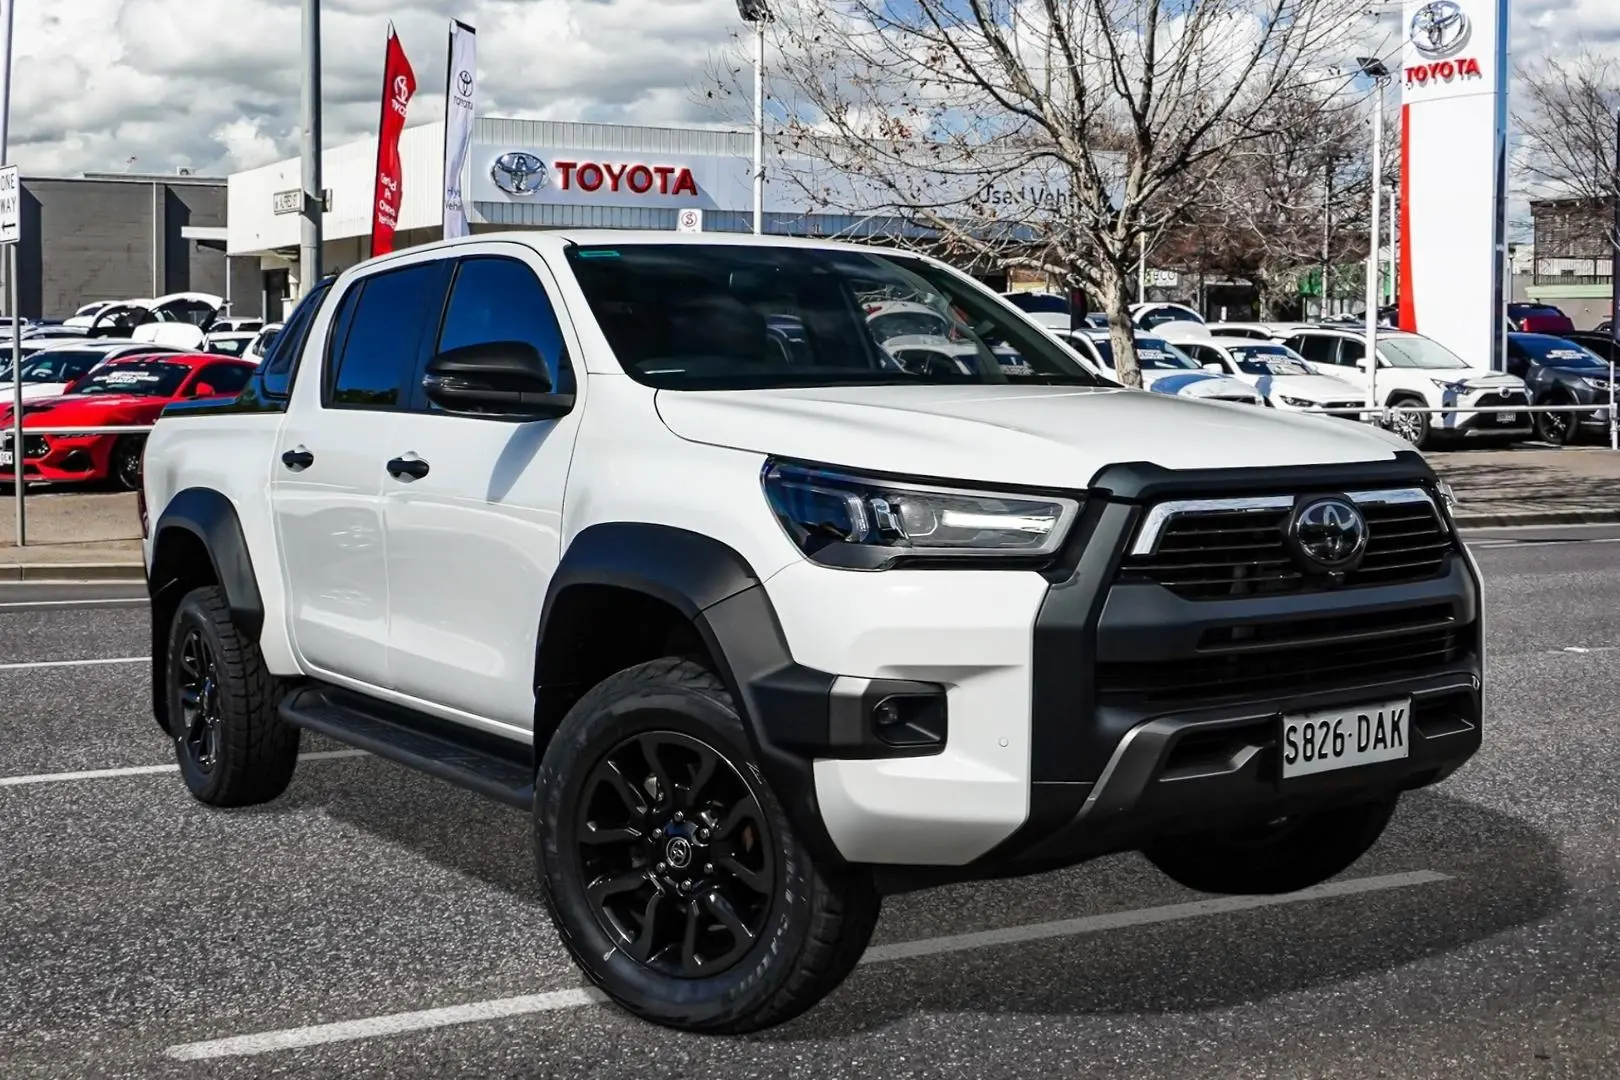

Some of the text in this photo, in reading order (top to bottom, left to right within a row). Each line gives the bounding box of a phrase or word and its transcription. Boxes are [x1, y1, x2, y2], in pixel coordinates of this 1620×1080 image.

[1404, 58, 1482, 83] TOYOTA
[1, 173, 15, 191] ONE
[554, 161, 698, 196] TOYOTA
[1, 196, 16, 214] WAY
